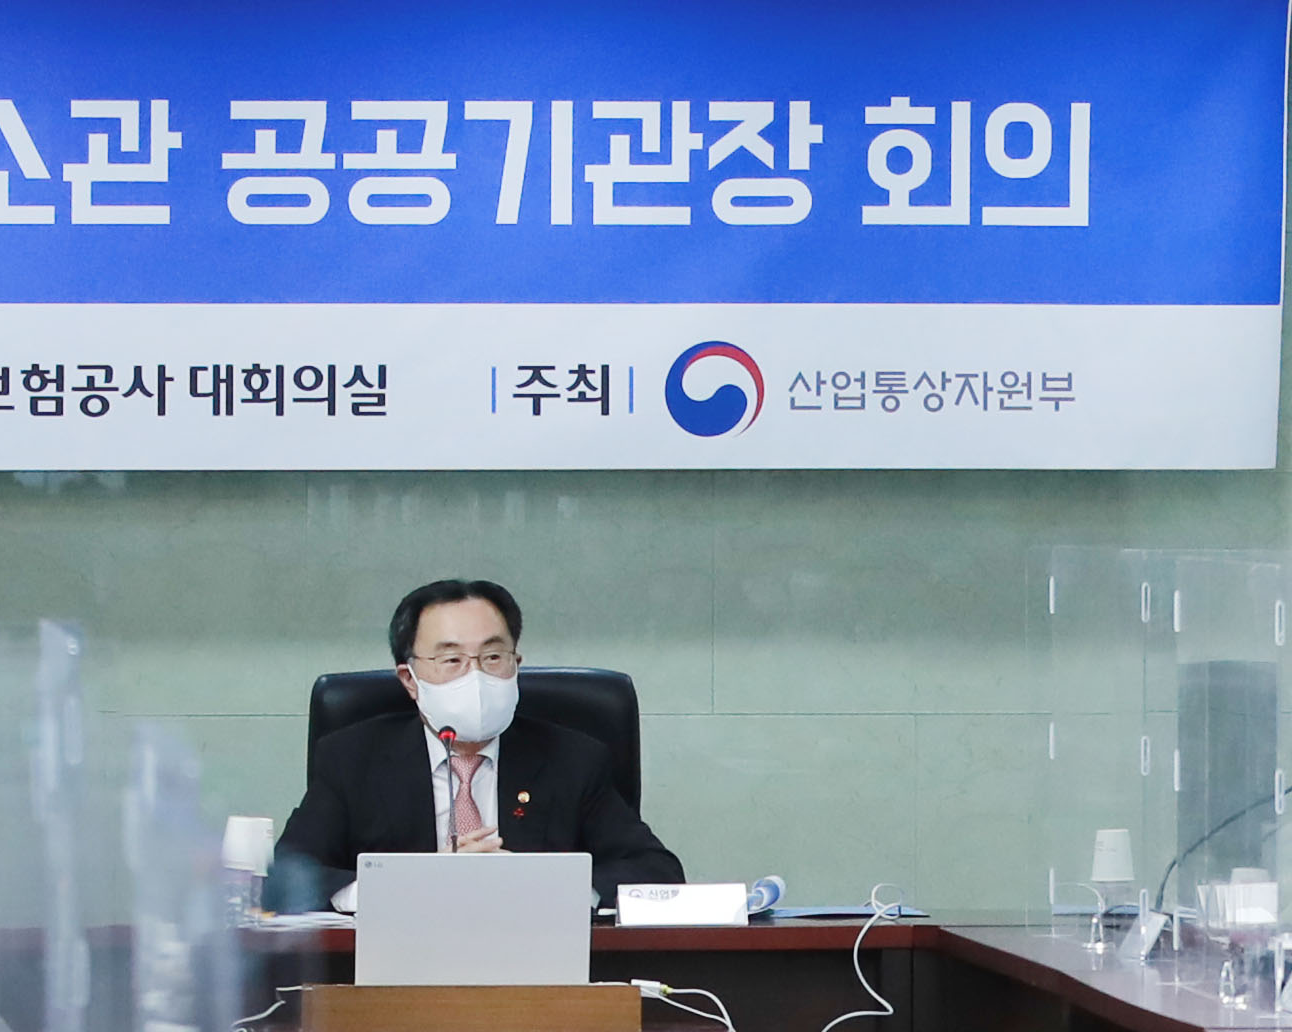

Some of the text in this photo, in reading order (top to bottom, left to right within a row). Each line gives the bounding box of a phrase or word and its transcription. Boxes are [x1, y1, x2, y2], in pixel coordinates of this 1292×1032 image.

[221, 100, 823, 226] 공공기관장
[862, 96, 1091, 227] 회의
[189, 363, 387, 417] 대회의실
[512, 363, 610, 417] 주최
[788, 371, 1076, 413] 산업통상자원부
